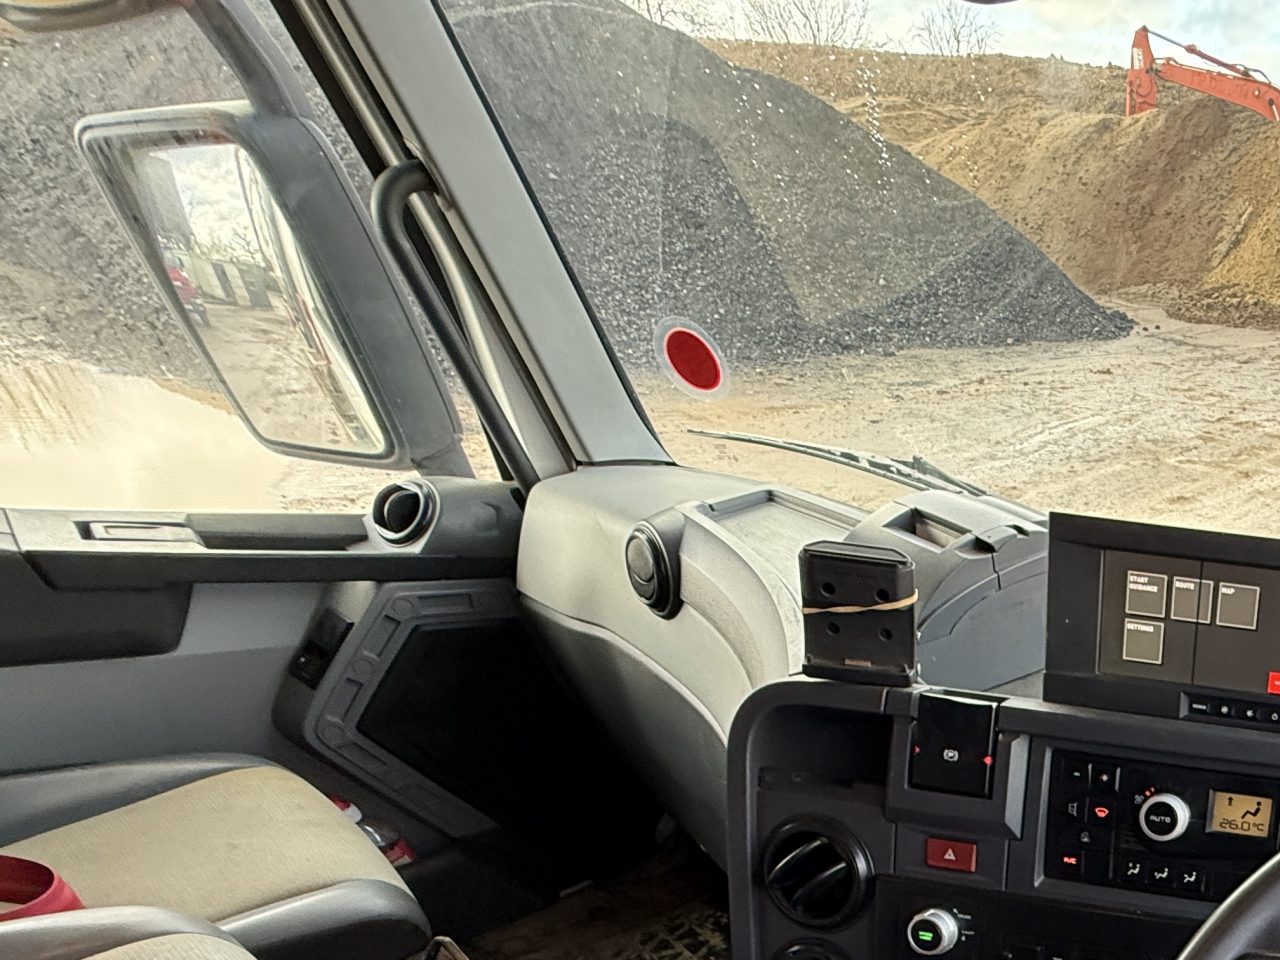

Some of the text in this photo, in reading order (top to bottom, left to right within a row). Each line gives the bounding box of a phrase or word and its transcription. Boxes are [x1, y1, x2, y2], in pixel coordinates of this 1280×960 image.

[1129, 575, 1149, 584] START
[1129, 582, 1159, 593] GUIDANCE
[1175, 580, 1195, 591] ROUTE
[1221, 586, 1236, 595] MAP
[1126, 623, 1155, 633] SETTINGS
[1150, 814, 1171, 824] AUTO
